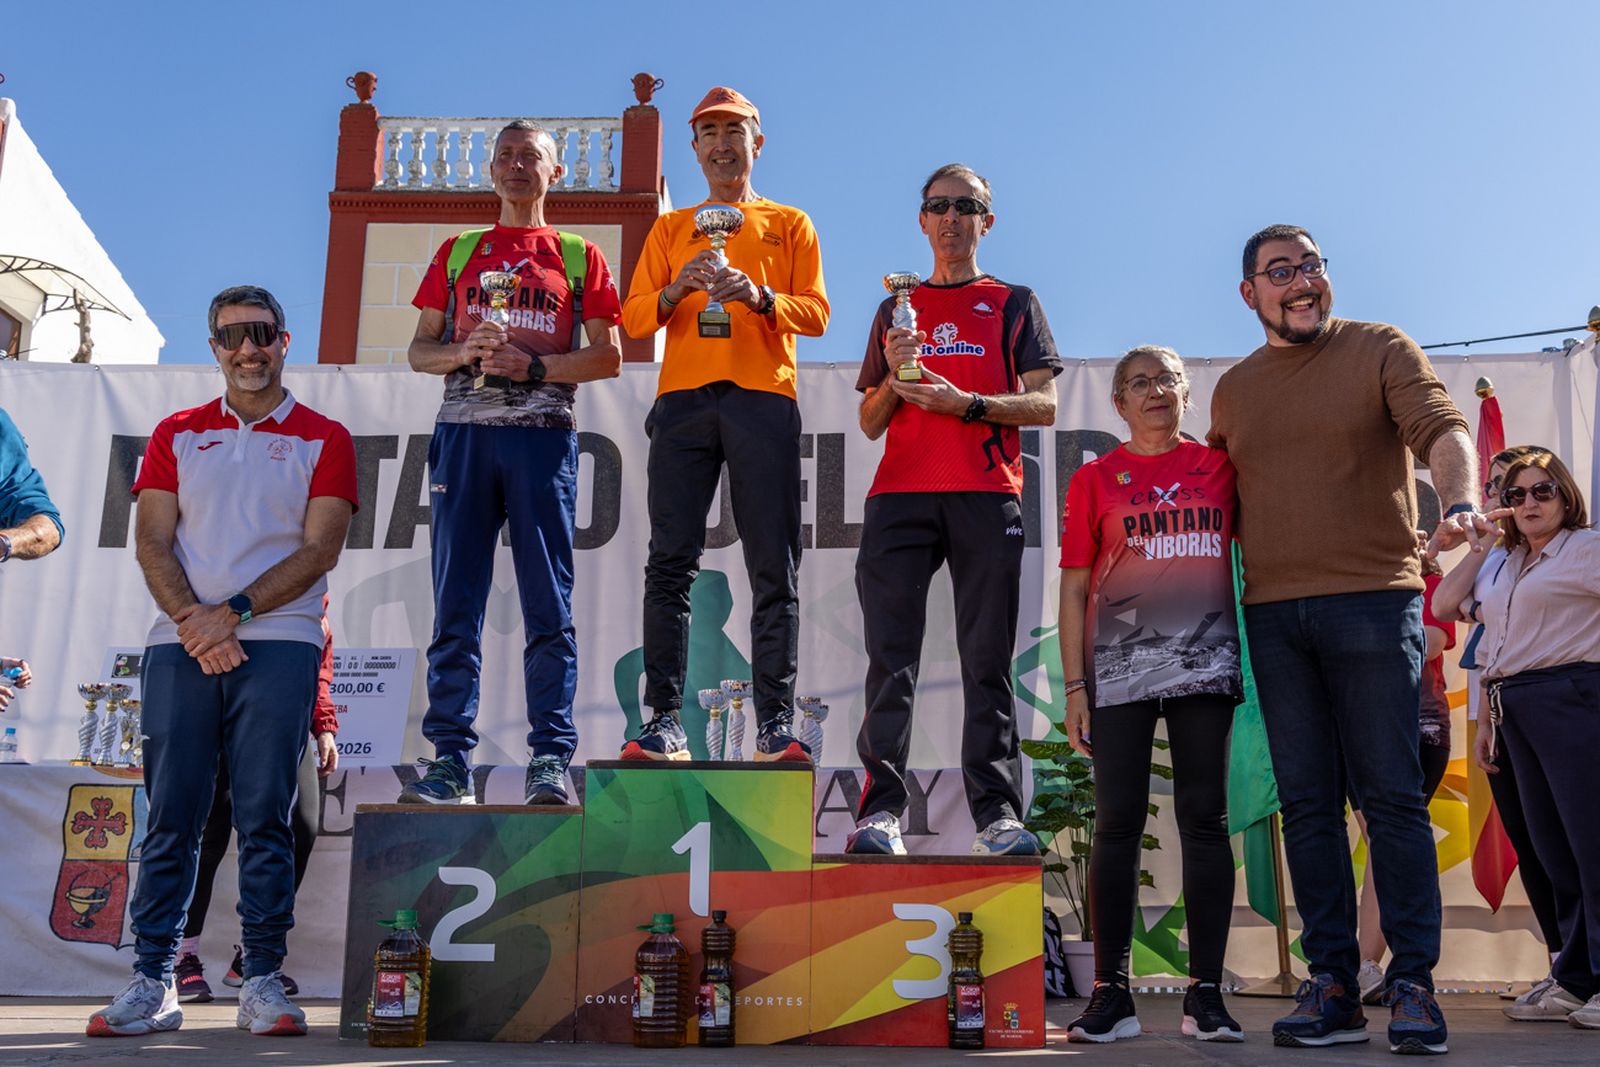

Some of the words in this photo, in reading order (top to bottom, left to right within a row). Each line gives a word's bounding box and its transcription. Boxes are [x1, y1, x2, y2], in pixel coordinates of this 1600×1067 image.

[936, 342, 984, 355] online
[1130, 487, 1206, 506] CROSS
[1123, 507, 1223, 538] PANTANO
[1128, 535, 1144, 547] DEL
[1144, 531, 1222, 560] VÍBORAS
[376, 682, 385, 693] €
[337, 742, 372, 754] 2026
[671, 822, 711, 917] 1
[429, 866, 497, 962] 2
[892, 903, 957, 1000] 3
[735, 996, 802, 1006] EPORTES
